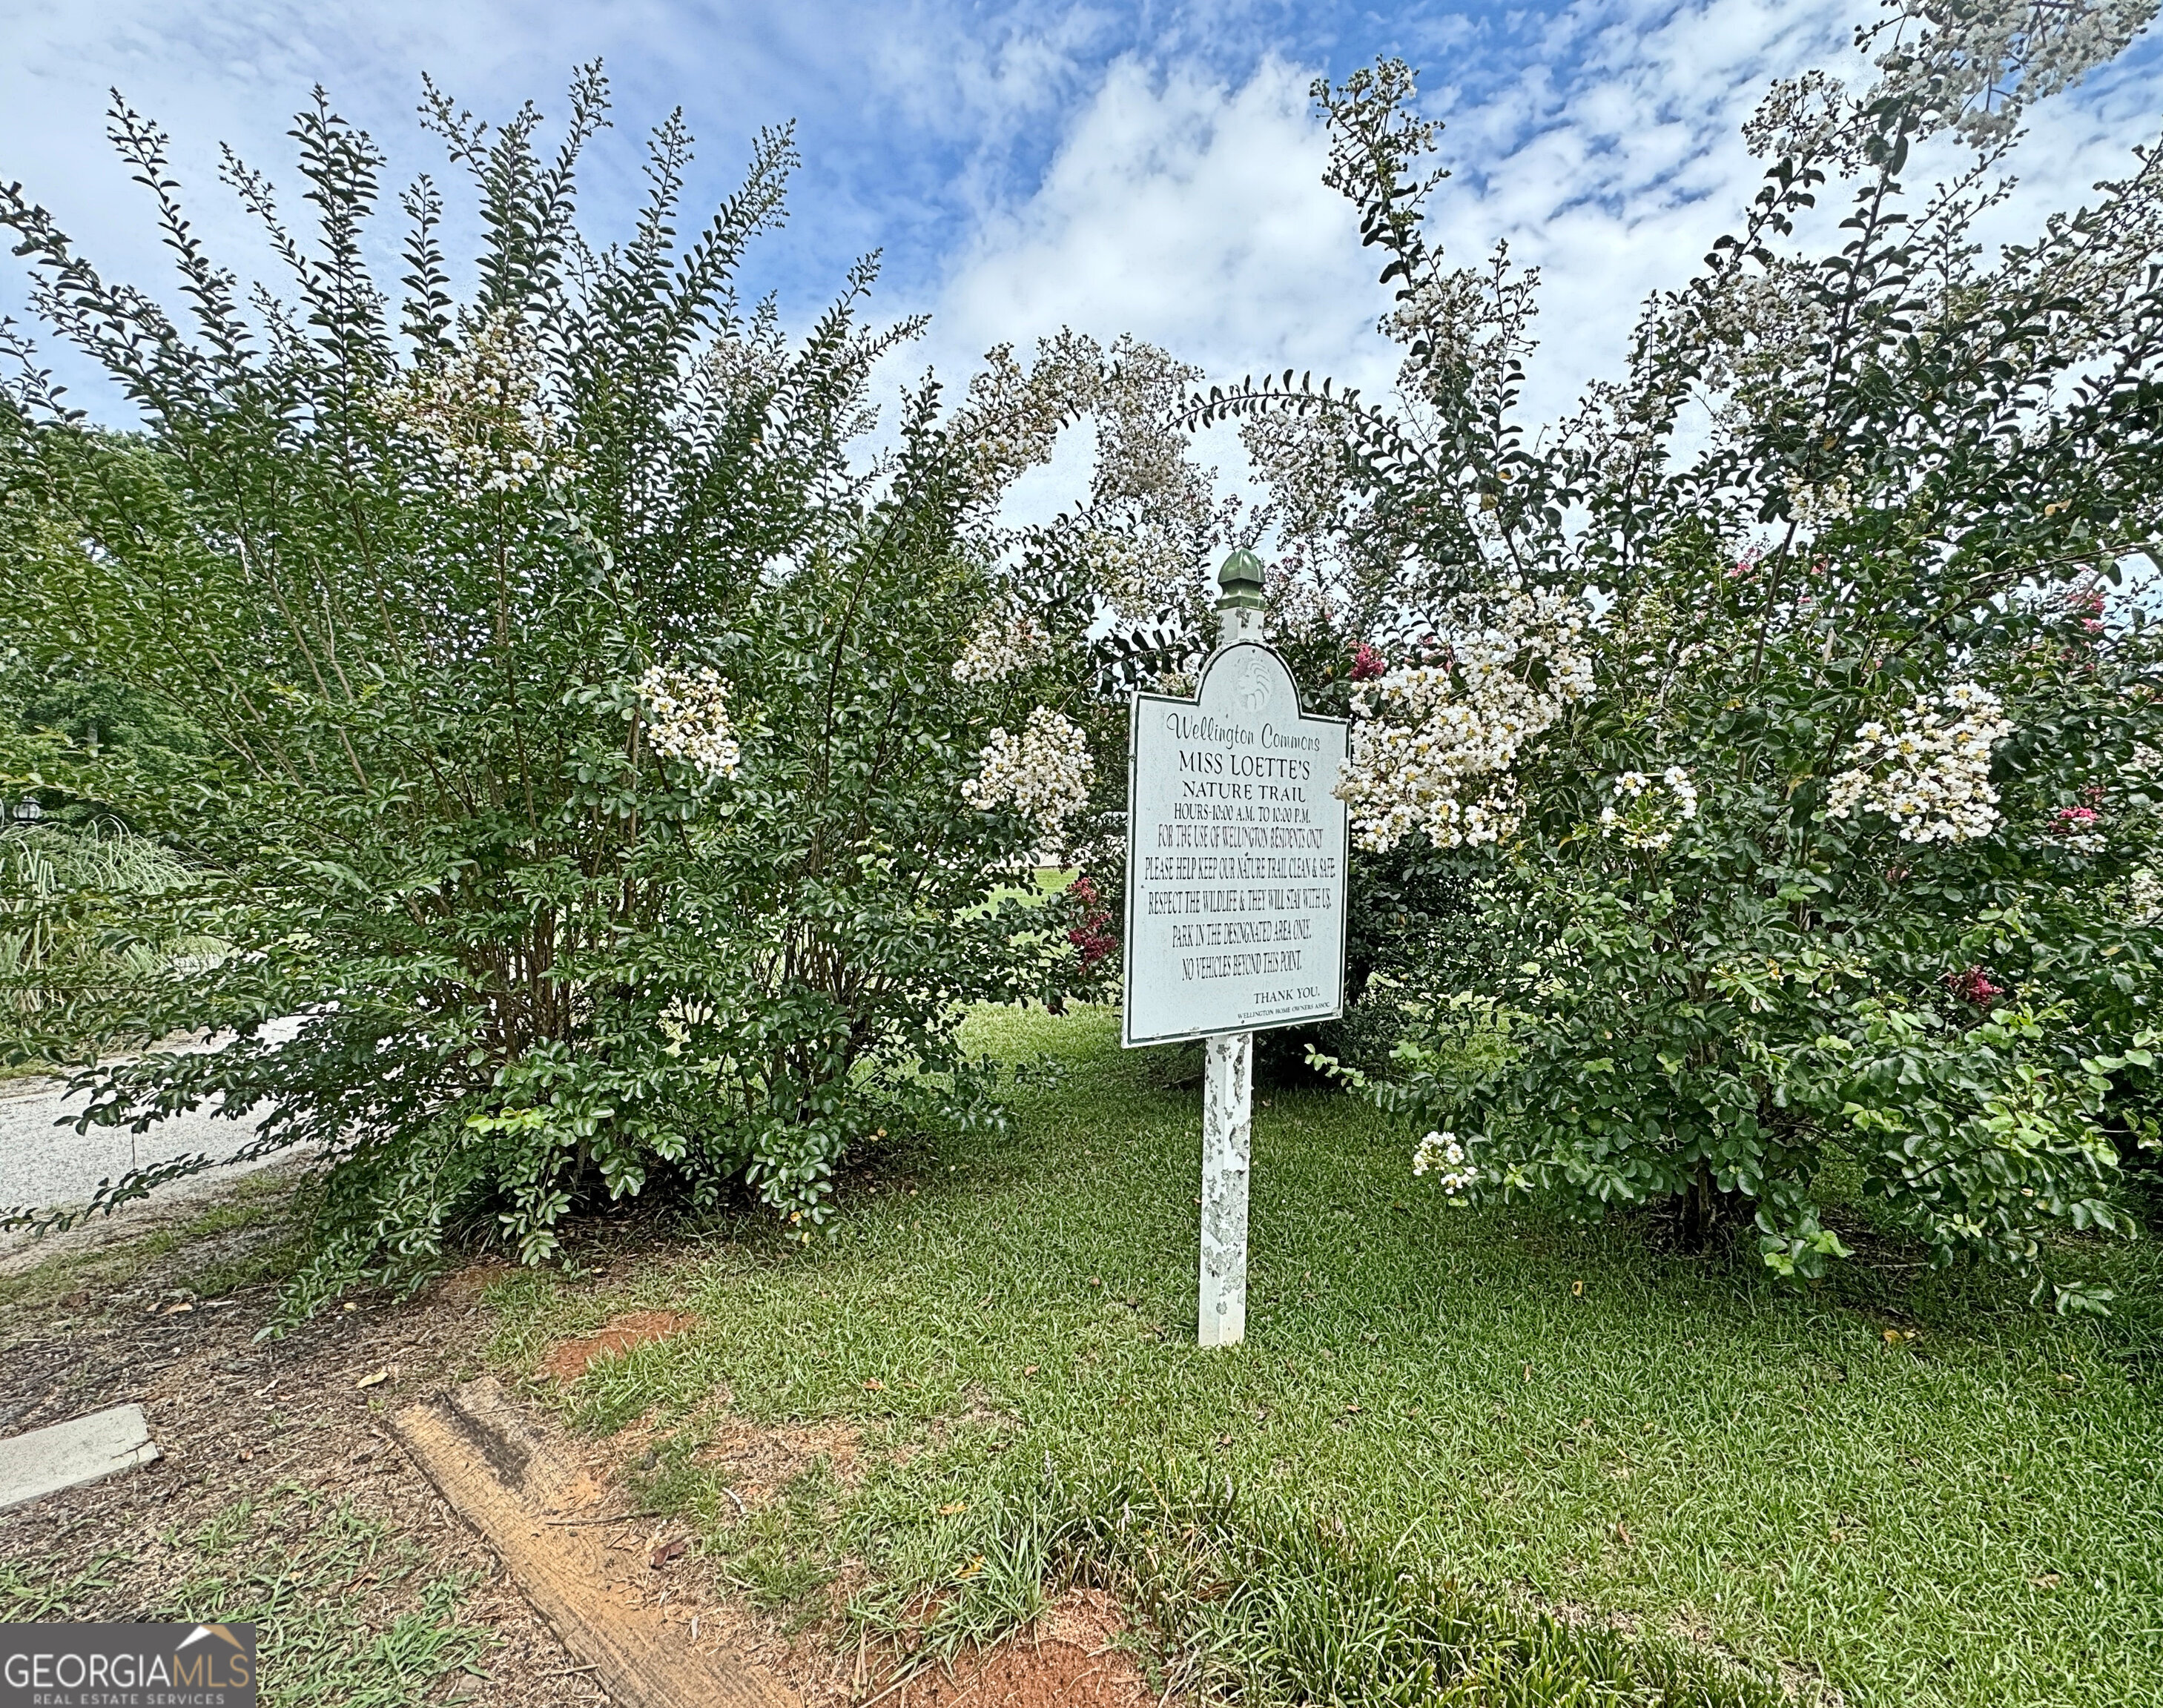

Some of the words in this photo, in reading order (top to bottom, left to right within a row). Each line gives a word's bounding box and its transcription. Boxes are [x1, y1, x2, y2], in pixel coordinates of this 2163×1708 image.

[1166, 713, 1254, 749] Wellington
[1261, 723, 1320, 752] Commons
[1179, 750, 1223, 774] MISS
[1230, 755, 1310, 780] LOETTE'S
[1182, 781, 1252, 800] NATURE
[1258, 785, 1306, 802] TRAIL
[1236, 806, 1255, 821] A.M.
[1258, 807, 1269, 822] TO
[1272, 807, 1292, 823] 10:00
[1295, 808, 1311, 824] P.M.
[1158, 824, 1173, 847] FOR
[1176, 824, 1192, 848] THE
[1194, 825, 1208, 848] USE
[1210, 825, 1221, 847] OF
[1222, 826, 1268, 848] WELLINGTON
[1270, 827, 1305, 849] RESIDENTS
[1307, 828, 1324, 850] ONLY
[1145, 857, 1173, 880] PLEASE
[1176, 857, 1196, 880] HELP
[1198, 857, 1218, 880] KEEP
[1219, 857, 1235, 879] OUR
[1237, 857, 1265, 879] NATURE
[1267, 857, 1287, 878] TRAIL
[1289, 857, 1311, 878] CLEAN
[1312, 857, 1318, 878] &
[1148, 891, 1183, 915] RESPECT
[1185, 890, 1201, 913] THE
[1203, 890, 1238, 913] WILDLIFE
[1239, 890, 1245, 912] &
[1247, 889, 1267, 911] THEY
[1268, 889, 1285, 910] WILL
[1287, 888, 1301, 910] STAY
[1302, 888, 1321, 909] WITH
[1172, 924, 1194, 948] PARK
[1195, 924, 1205, 947] IN
[1206, 923, 1222, 946] THE
[1224, 921, 1272, 944] DESINGNATED
[1273, 920, 1292, 941] AREA
[1292, 918, 1312, 940] ONLY.
[1182, 958, 1195, 981] NO
[1196, 955, 1232, 979] VEHICLES
[1233, 953, 1261, 976] BEYOND
[1263, 951, 1279, 973] THIS
[1280, 950, 1302, 971] POINT.
[1253, 989, 1293, 1004] THANK
[1297, 986, 1320, 999] YOU.
[1238, 1009, 1274, 1019] WELLINGTON
[1292, 1004, 1314, 1013] OWNERS
